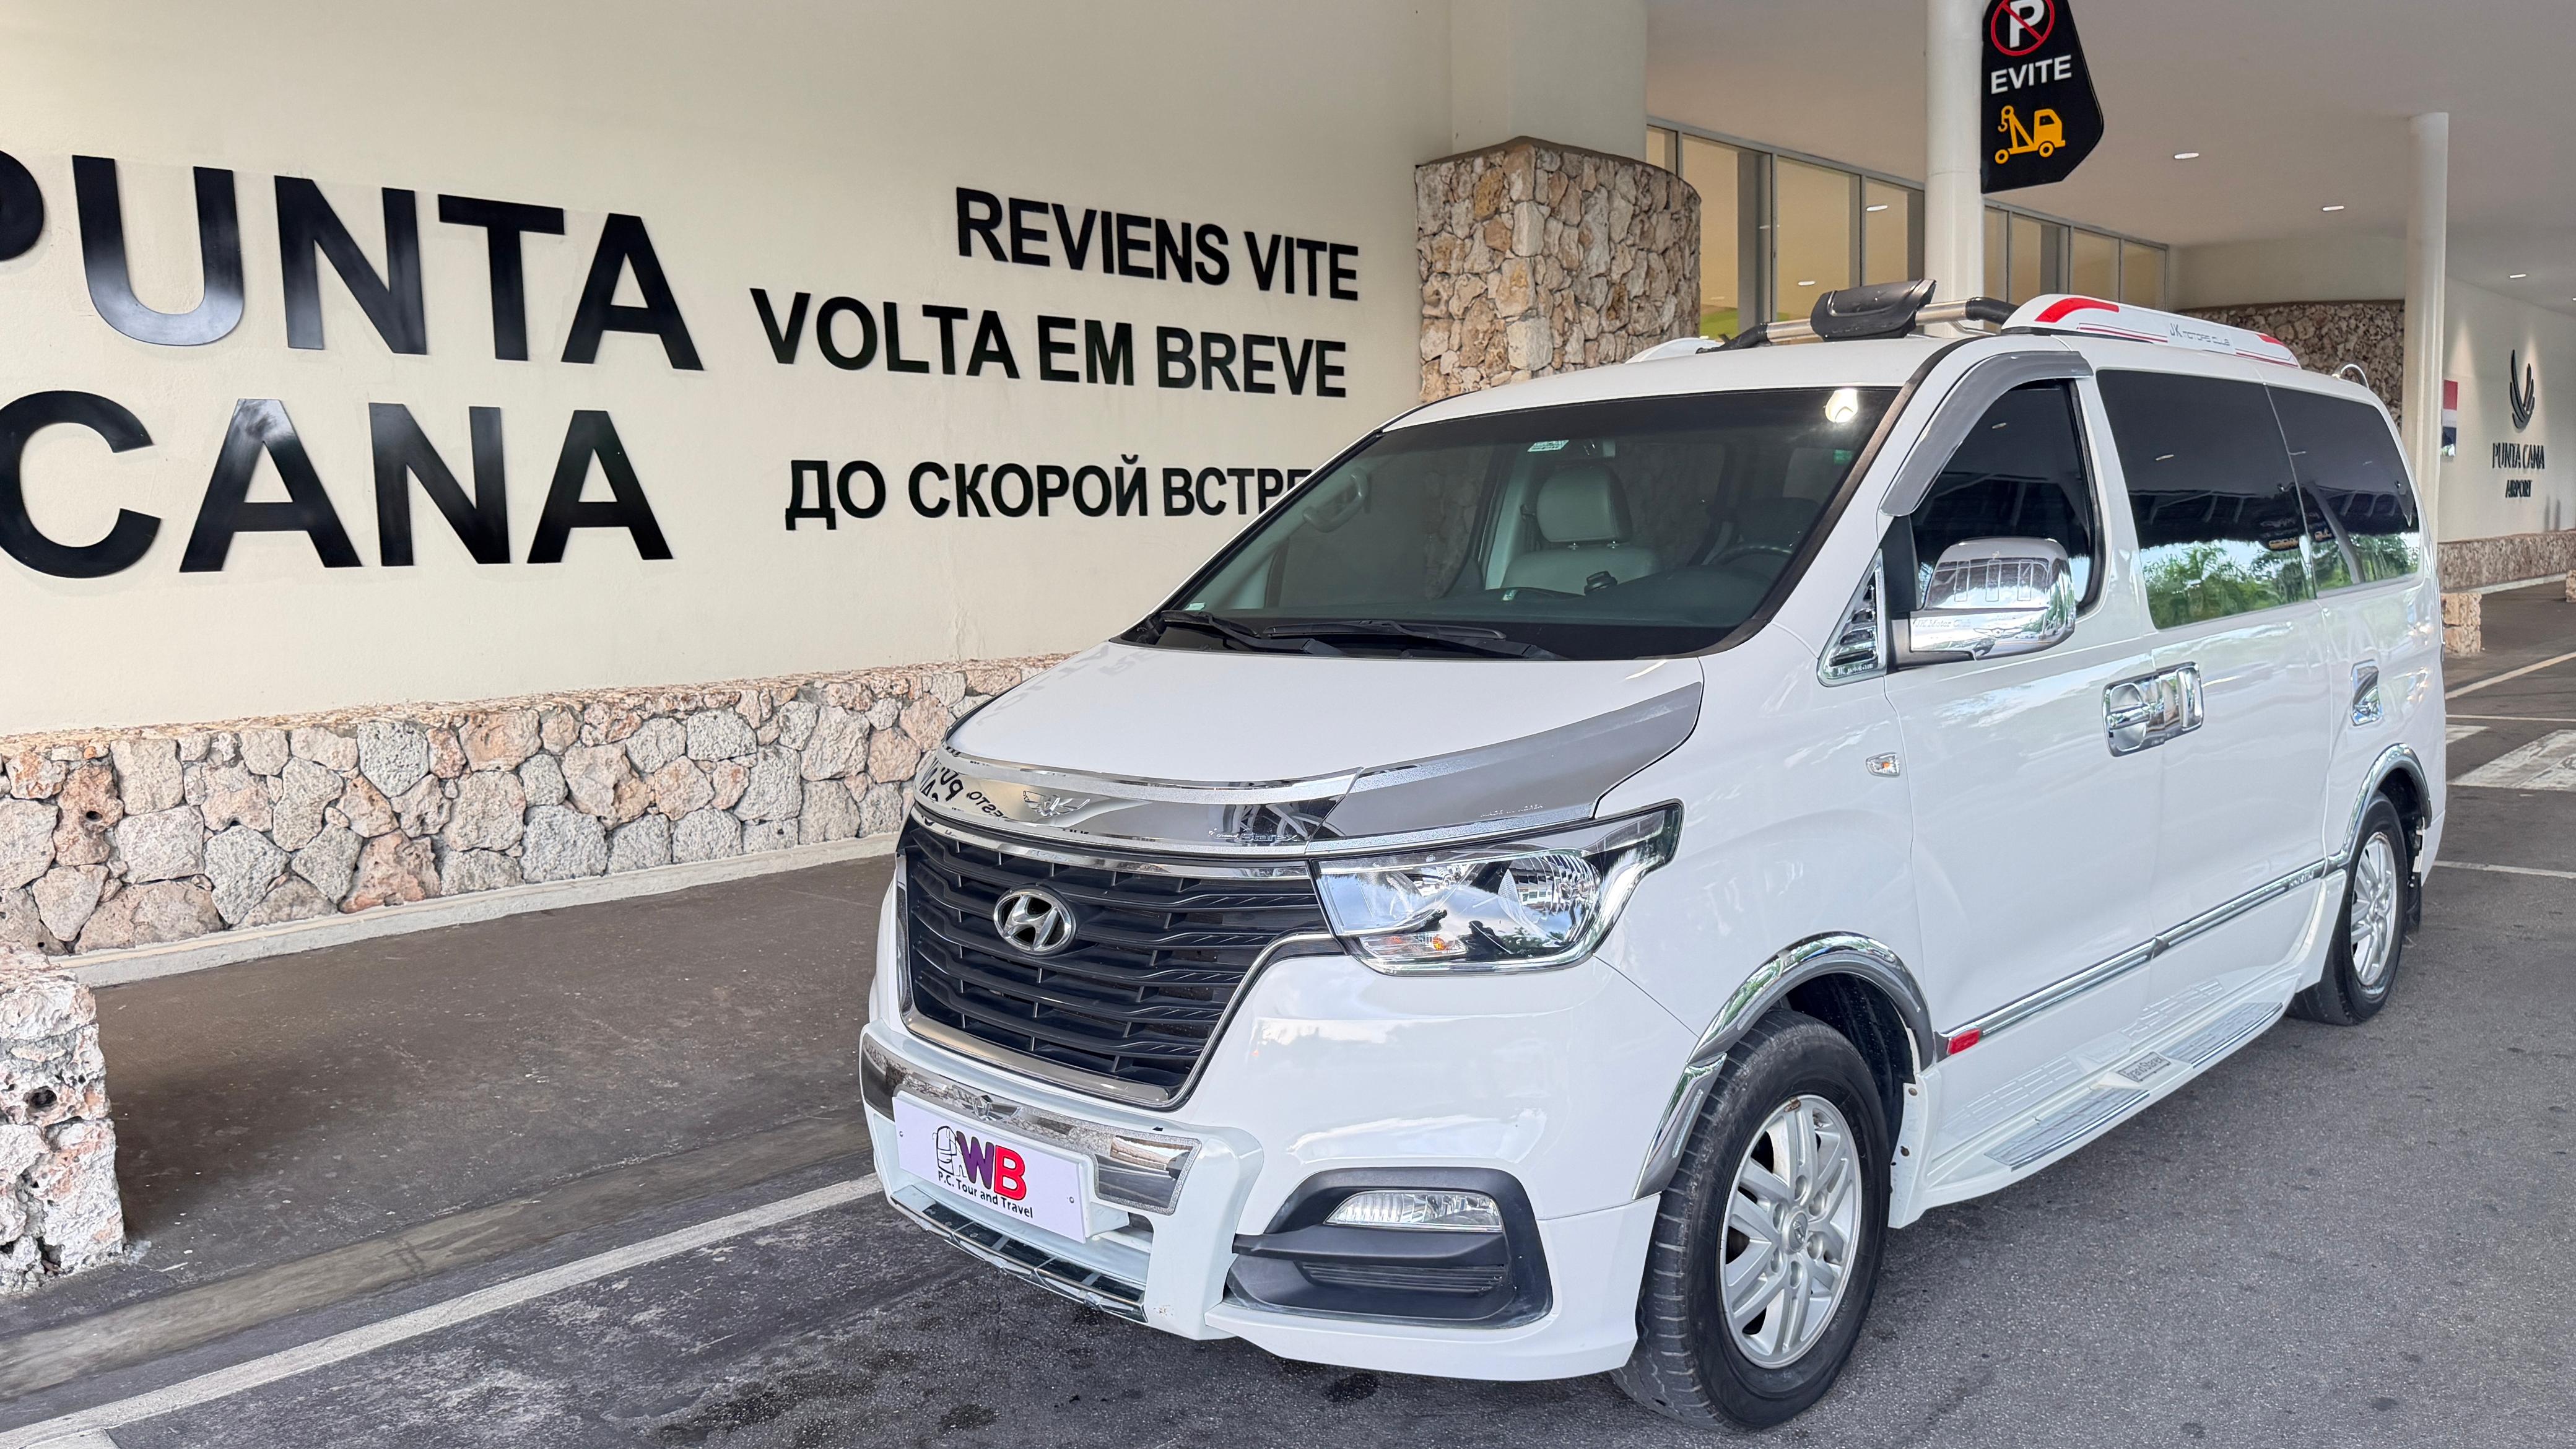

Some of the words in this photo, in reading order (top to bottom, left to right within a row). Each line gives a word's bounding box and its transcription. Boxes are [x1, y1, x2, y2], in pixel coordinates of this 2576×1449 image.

[1990, 54, 2072, 95] EVITE
[955, 186, 1230, 286] REVIENS
[1243, 231, 1359, 302] VITE
[749, 287, 1020, 379] VOLTA
[1037, 315, 1134, 386] EM
[1156, 326, 1346, 398] BREVE
[0, 390, 674, 580] CANA
[2492, 442, 2521, 469] PUNTA
[2522, 443, 2545, 469] CANA
[2505, 479, 2533, 498] AIRPORT
[785, 459, 886, 531] ДО
[908, 454, 1148, 518] СКОРОЙ
[938, 1170, 954, 1187] P.C.
[956, 1178, 978, 1197] Tour
[980, 1191, 999, 1206] and
[1001, 1196, 1033, 1219] Travel
[956, 1130, 1027, 1200] WB
